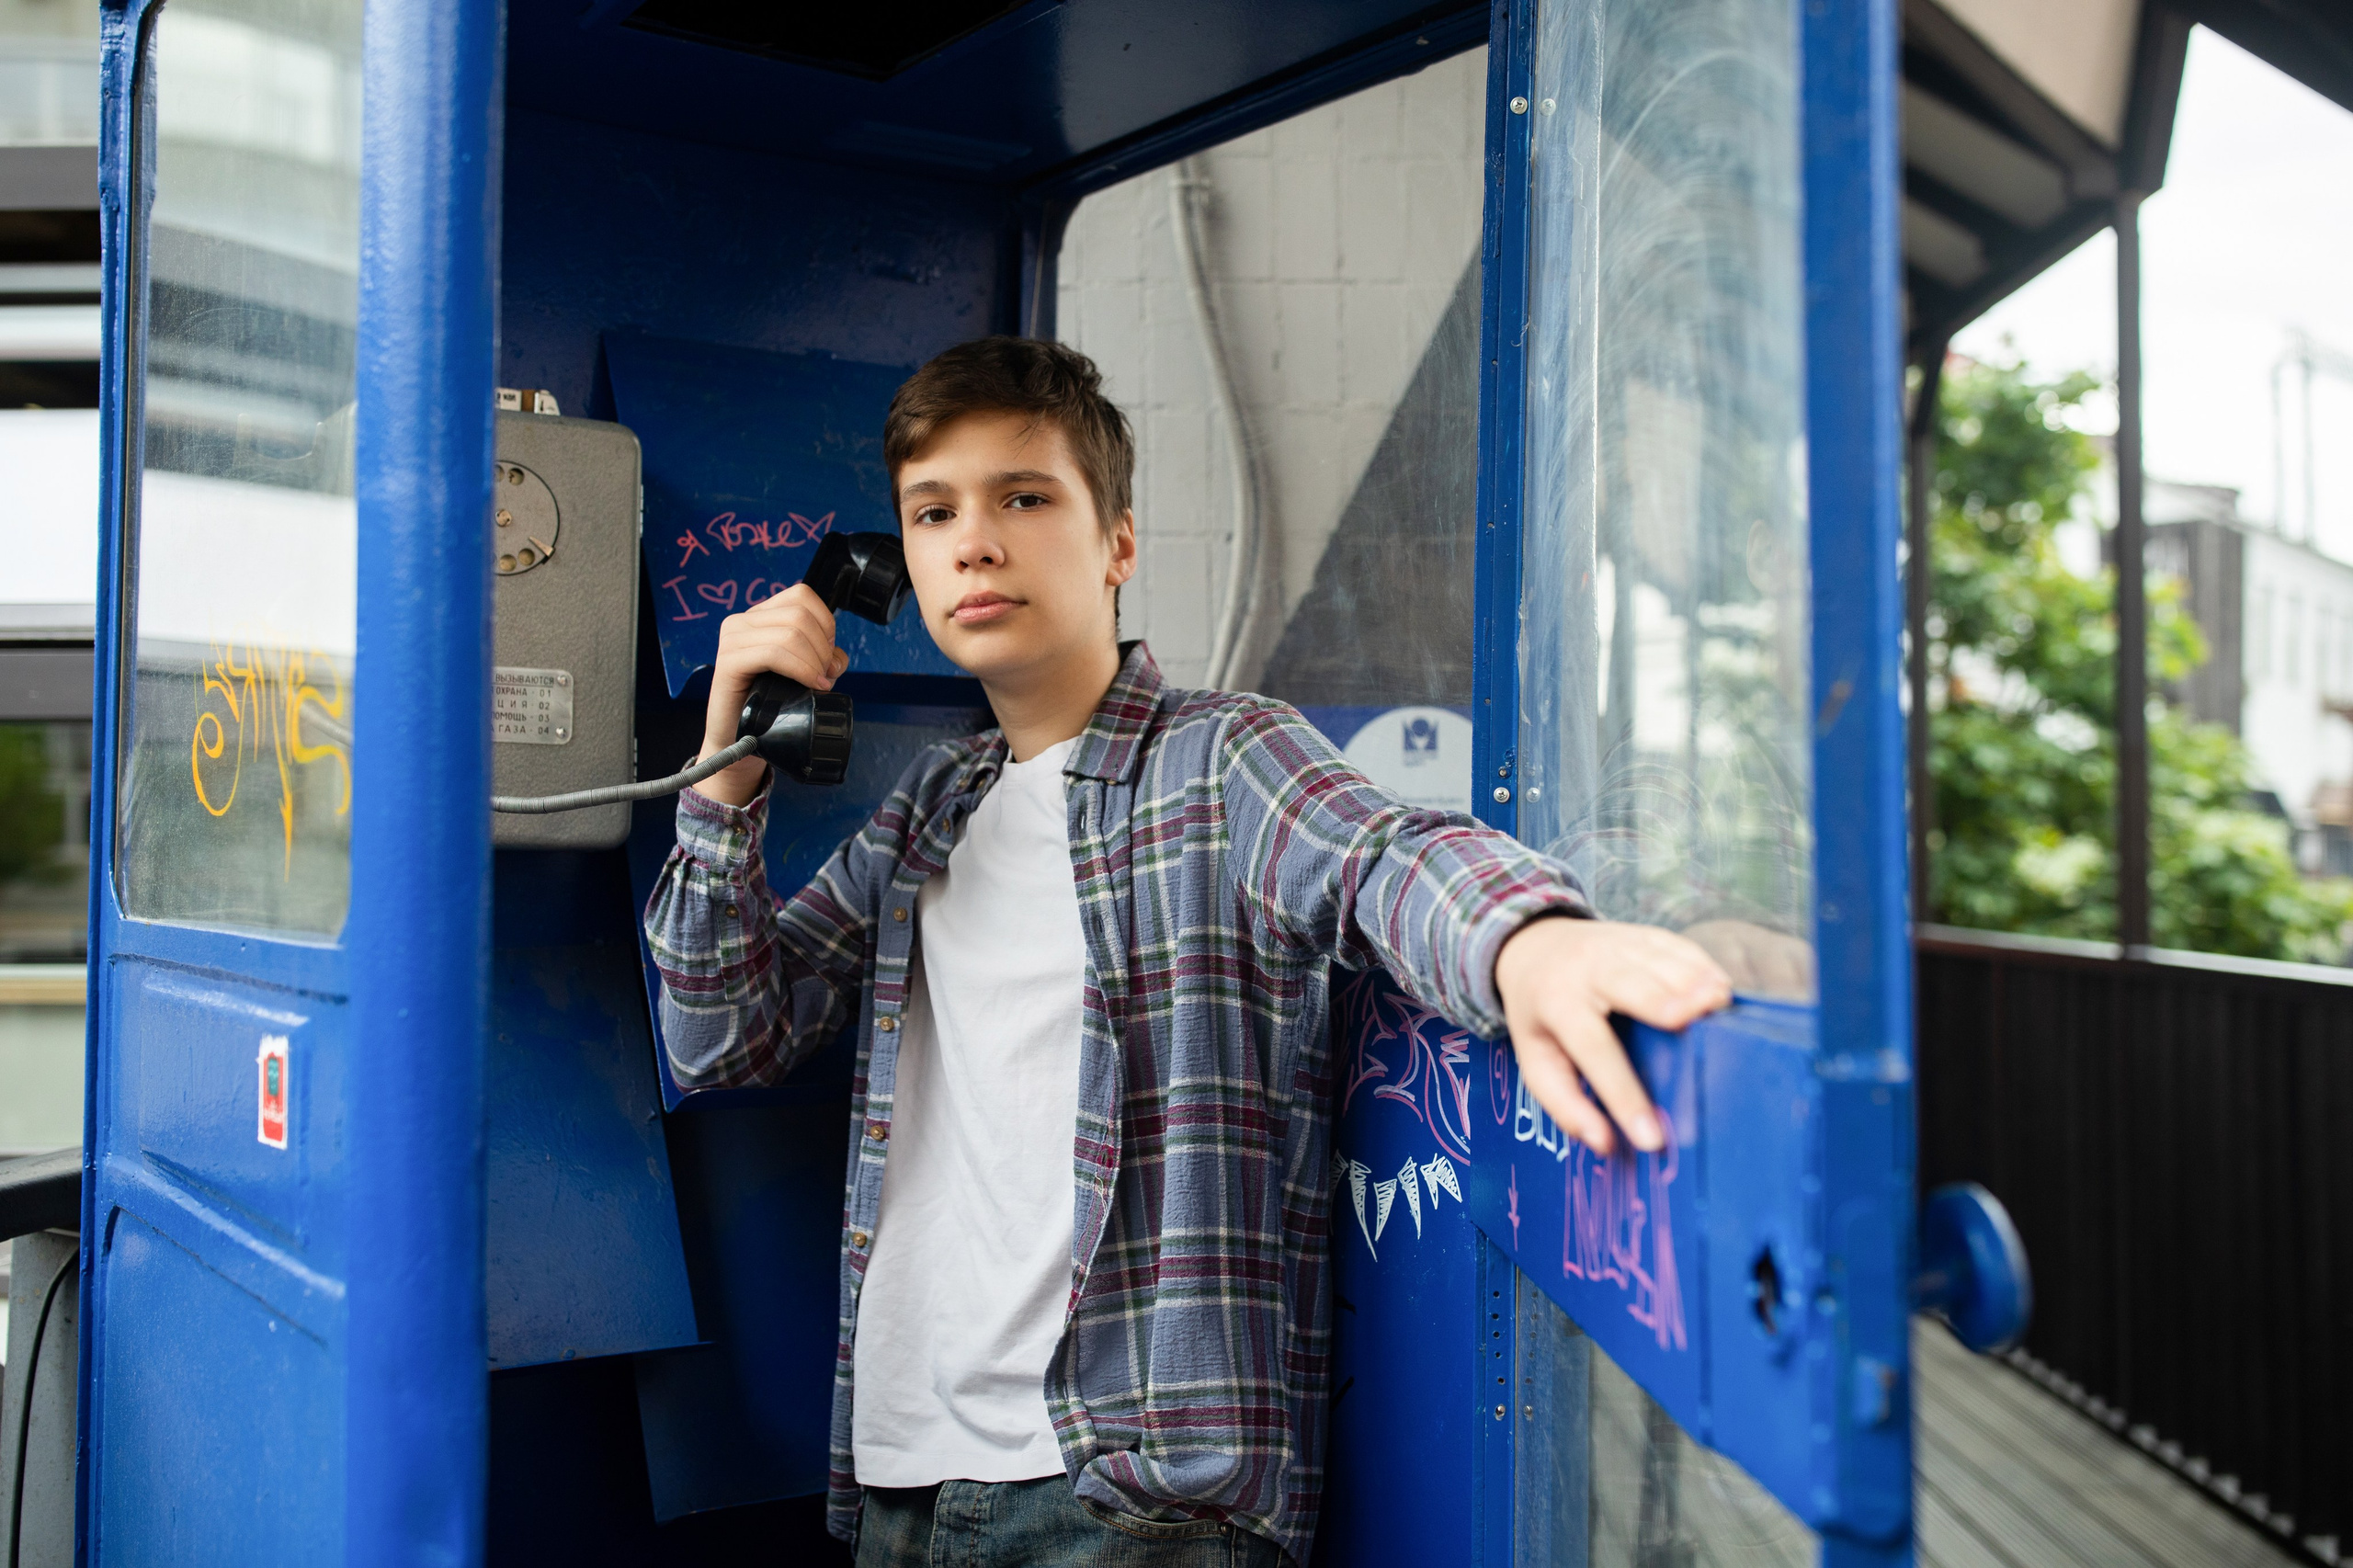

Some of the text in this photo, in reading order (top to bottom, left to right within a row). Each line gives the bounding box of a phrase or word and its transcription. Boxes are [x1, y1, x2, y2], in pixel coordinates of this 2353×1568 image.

[495, 674, 554, 685] ВЫЗЫВАЮТСЯ
[495, 687, 528, 696] ОХРАНА
[496, 699, 551, 710] ЦИЯ 02
[538, 714, 550, 722] 03
[498, 725, 526, 733] ГАЗА
